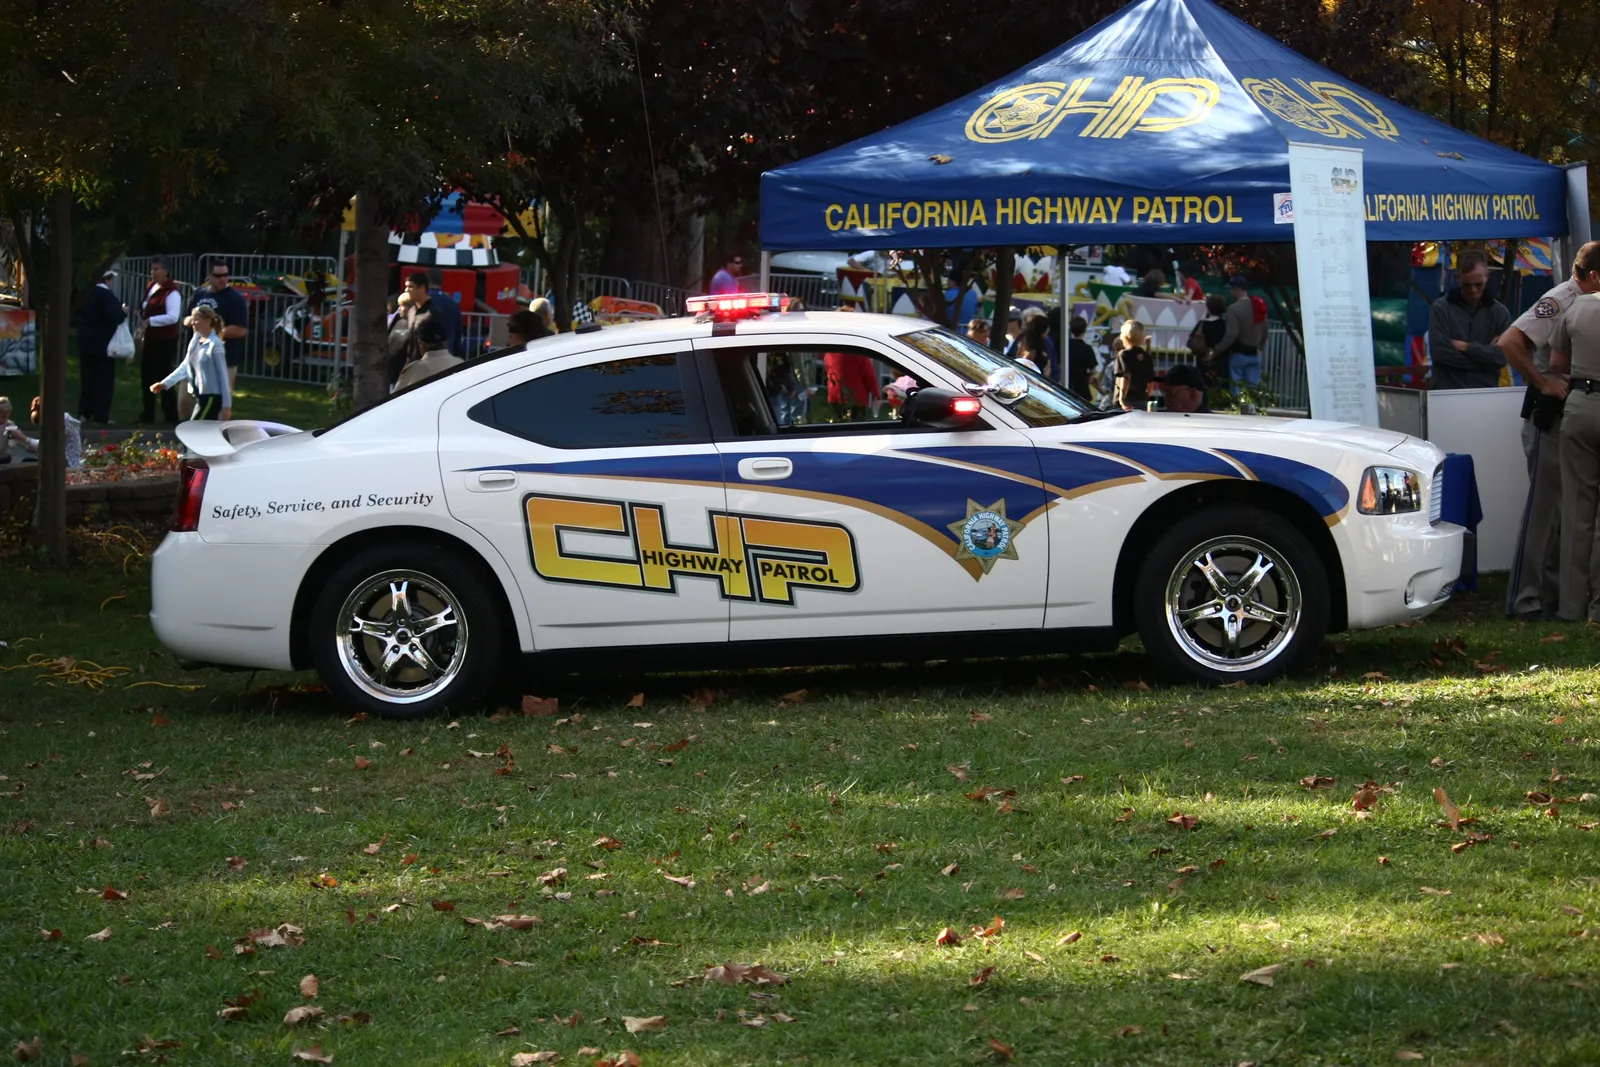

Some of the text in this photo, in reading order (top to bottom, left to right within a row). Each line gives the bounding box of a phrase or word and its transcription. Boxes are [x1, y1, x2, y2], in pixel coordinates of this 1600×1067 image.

[825, 195, 1243, 231] CALIFORNIA HIGHWAY PATROL
[1432, 193, 1489, 221] HIGHWAY
[1492, 194, 1540, 220] PATROL
[211, 491, 434, 520] Safety, Service, and Security
[521, 490, 863, 607] CHP
[963, 512, 1009, 551] CALIFORNIA HIGHWAY PATROL
[642, 550, 839, 584] HIGHWAY PATROL
